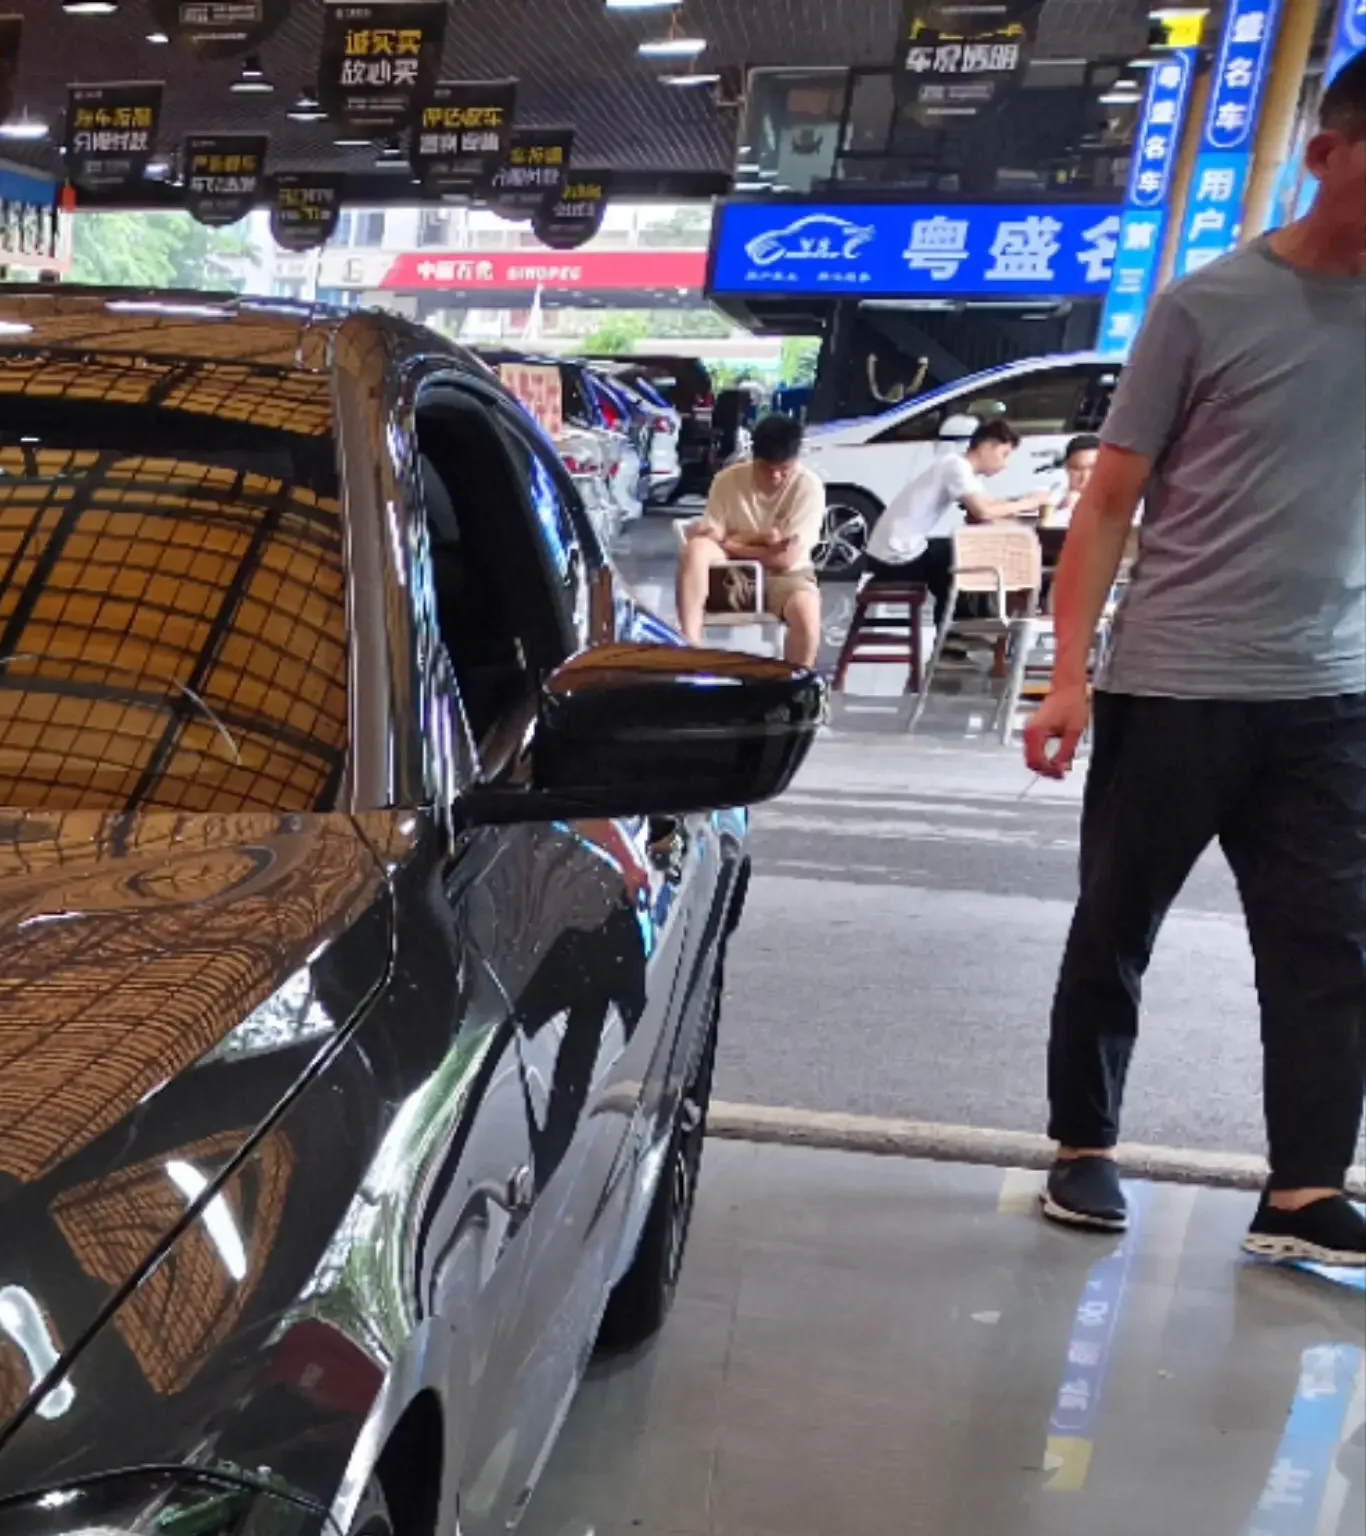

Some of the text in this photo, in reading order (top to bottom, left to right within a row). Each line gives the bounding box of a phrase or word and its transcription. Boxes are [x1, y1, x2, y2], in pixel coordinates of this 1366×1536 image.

[417, 260, 583, 281] 中国石化 SINOPEC
